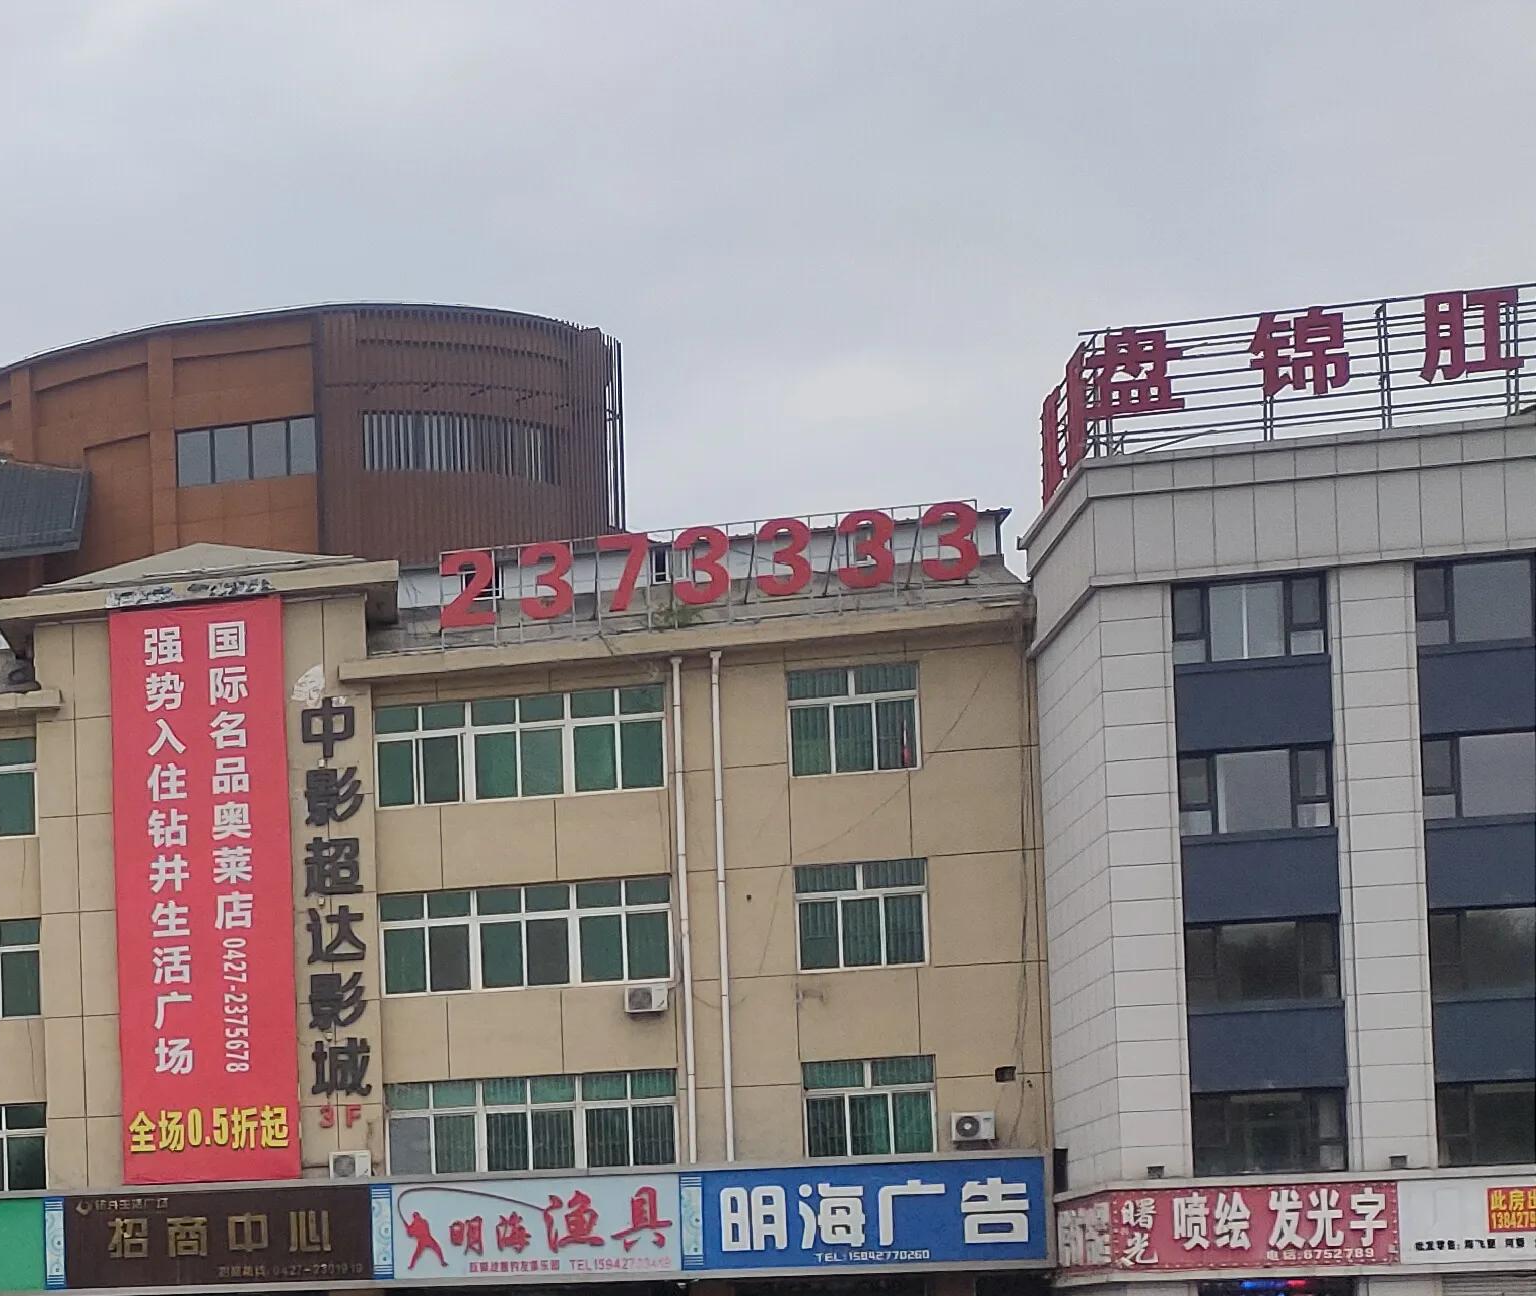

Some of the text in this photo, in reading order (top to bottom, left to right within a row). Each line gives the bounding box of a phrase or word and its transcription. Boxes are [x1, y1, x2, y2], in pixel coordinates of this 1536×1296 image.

[439, 501, 971, 628] 2373333
[143, 626, 195, 1077] 强势入住钻井生活广场
[207, 619, 254, 1074] 国际名品奥莱店 0427-2375678
[300, 695, 374, 1100] 中影超达影城
[128, 1104, 290, 1156] 全场0.5折起
[107, 1209, 333, 1259] 招商中心
[448, 1185, 674, 1256] 明海渔具
[719, 1176, 1030, 1252] 明海广告
[1118, 1197, 1159, 1267] 曙光
[1173, 1190, 1252, 1251] 喷绘
[1267, 1186, 1389, 1249] 发光字
